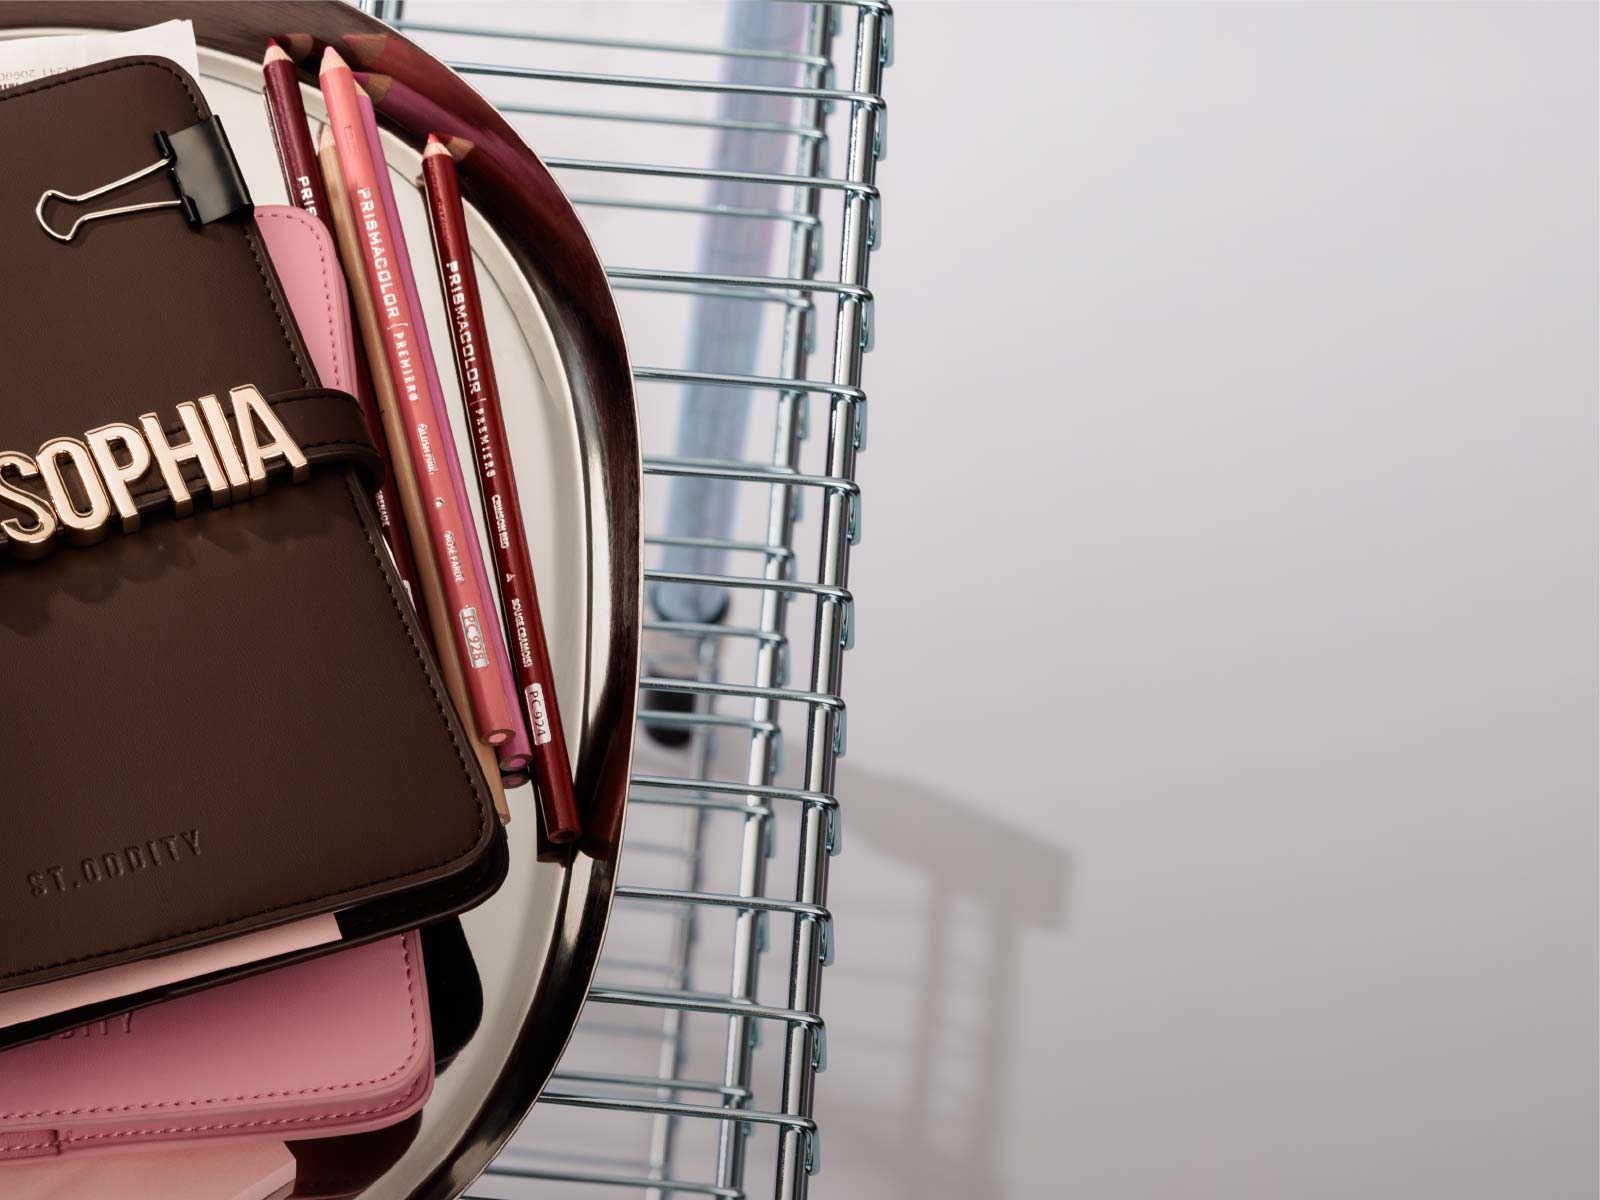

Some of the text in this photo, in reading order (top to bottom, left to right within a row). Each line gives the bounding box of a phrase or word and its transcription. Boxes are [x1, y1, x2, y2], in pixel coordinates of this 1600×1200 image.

[357, 187, 400, 319] PRISMACOLOR
[446, 260, 481, 395] PRISMACOLOR
[463, 615, 485, 661] PC 928
[529, 690, 547, 737] PC 924
[27, 829, 201, 897] ST.ODDITY
